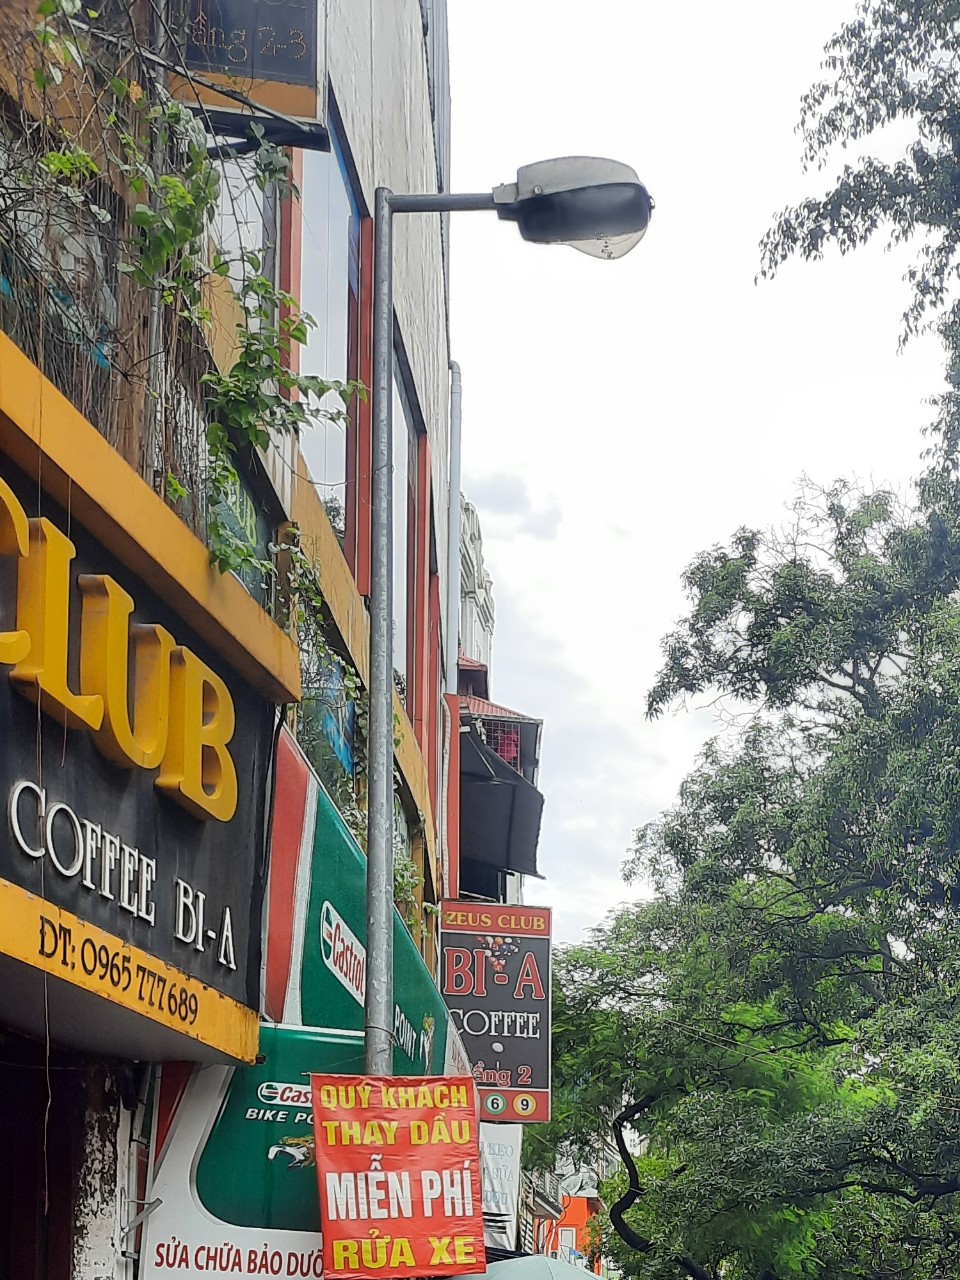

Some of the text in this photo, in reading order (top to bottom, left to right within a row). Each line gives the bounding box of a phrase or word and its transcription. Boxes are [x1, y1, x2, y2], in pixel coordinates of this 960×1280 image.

[11, 780, 237, 970] COFFEE BI-A
[446, 911, 545, 930] ZEUS CLUB
[332, 922, 365, 998] Castrol
[81, 938, 131, 992] 0965
[136, 964, 166, 1012] 777
[168, 985, 198, 1026] 689
[449, 1008, 540, 1039] COFFEE
[517, 1065, 532, 1085] 2
[279, 1086, 312, 1104] Cas
[382, 1081, 468, 1110] KHÁCH
[490, 1097, 529, 1112] 6 9
[245, 1108, 288, 1122] BIKE
[321, 1112, 471, 1146] THAY DẦU
[325, 1153, 474, 1221] MIỄN PHÍ
[155, 1236, 323, 1279] SỬA CHỮA BẢO DƯỠ
[332, 1228, 477, 1270] RỬA XE
